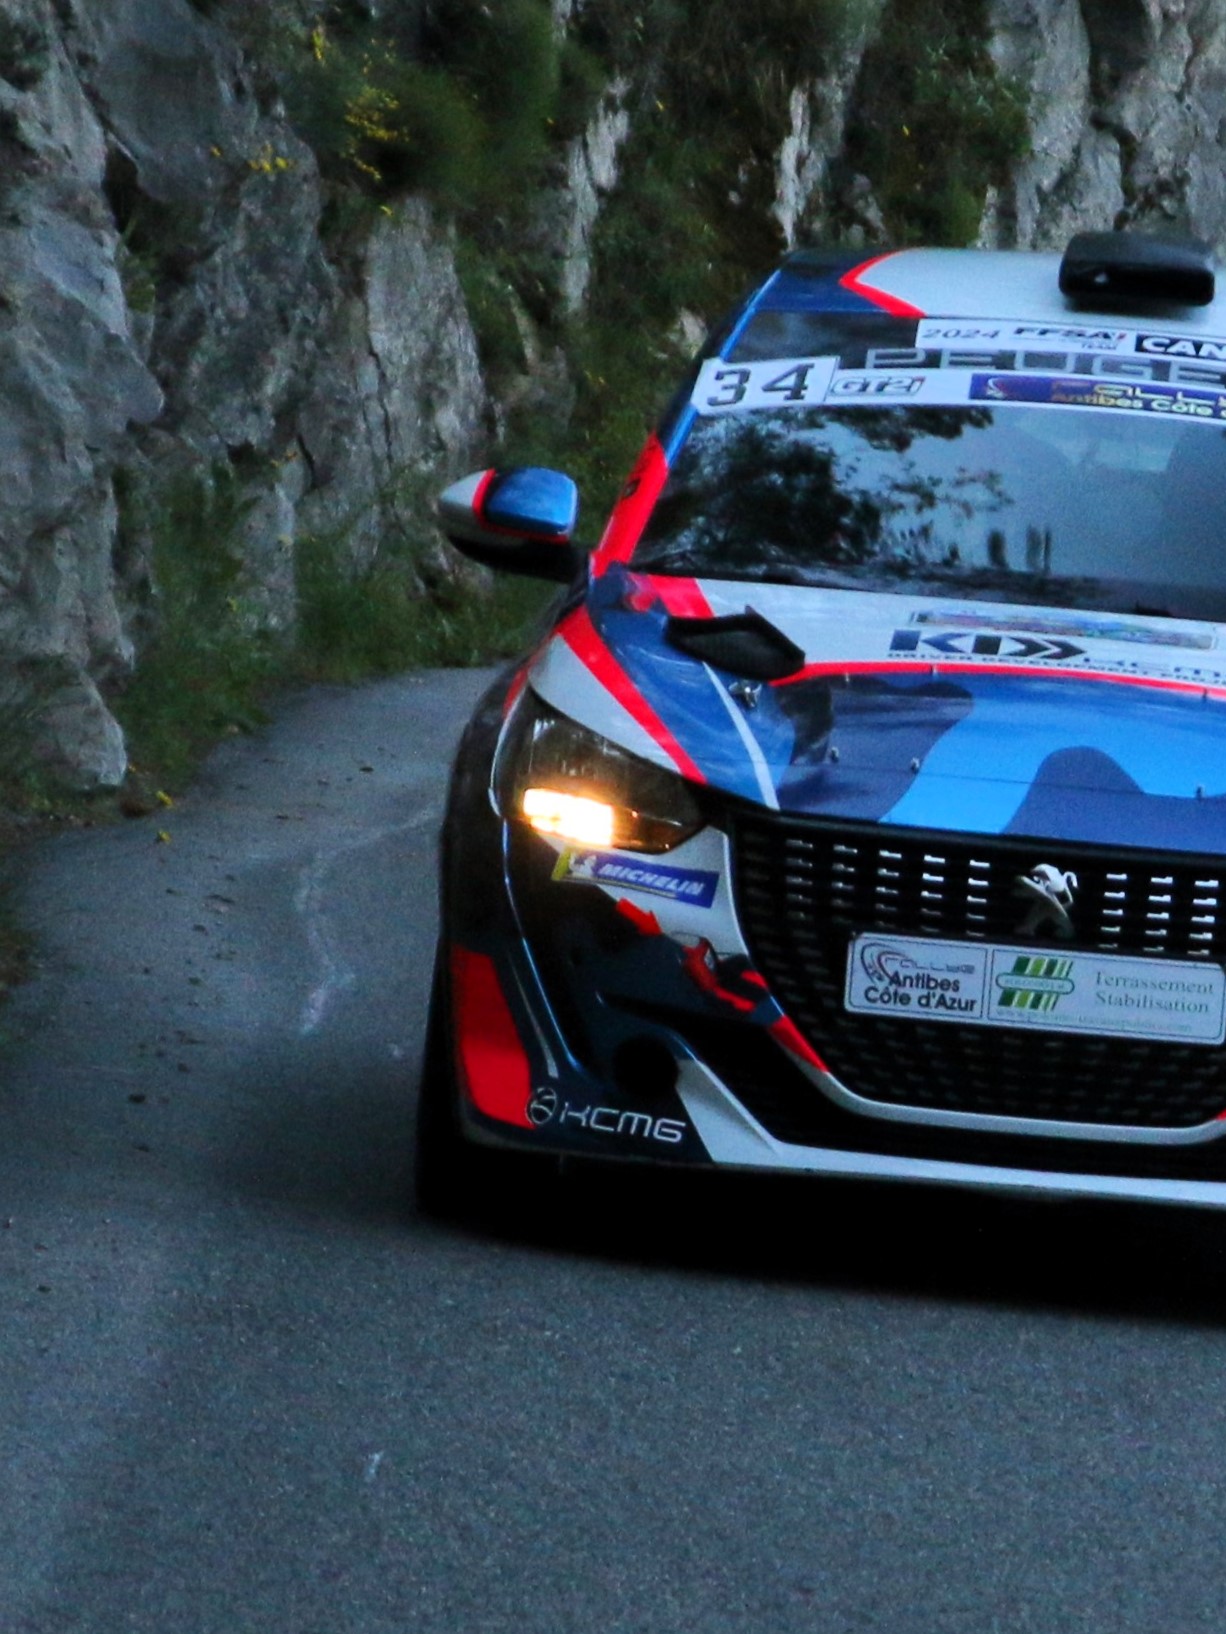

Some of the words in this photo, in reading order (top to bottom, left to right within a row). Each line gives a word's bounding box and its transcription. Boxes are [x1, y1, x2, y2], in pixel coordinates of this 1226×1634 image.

[921, 327, 1001, 340] 2024
[707, 363, 815, 406] 34
[1150, 398, 1214, 418] Côte
[599, 863, 705, 896] MICHELIN
[889, 970, 961, 993] Antibes
[1095, 971, 1215, 995] Terrassement
[864, 985, 912, 1006] Côte
[917, 991, 978, 1013] d'Azur
[1094, 991, 1210, 1014] Stabilisation
[559, 1101, 687, 1144] KCMG
